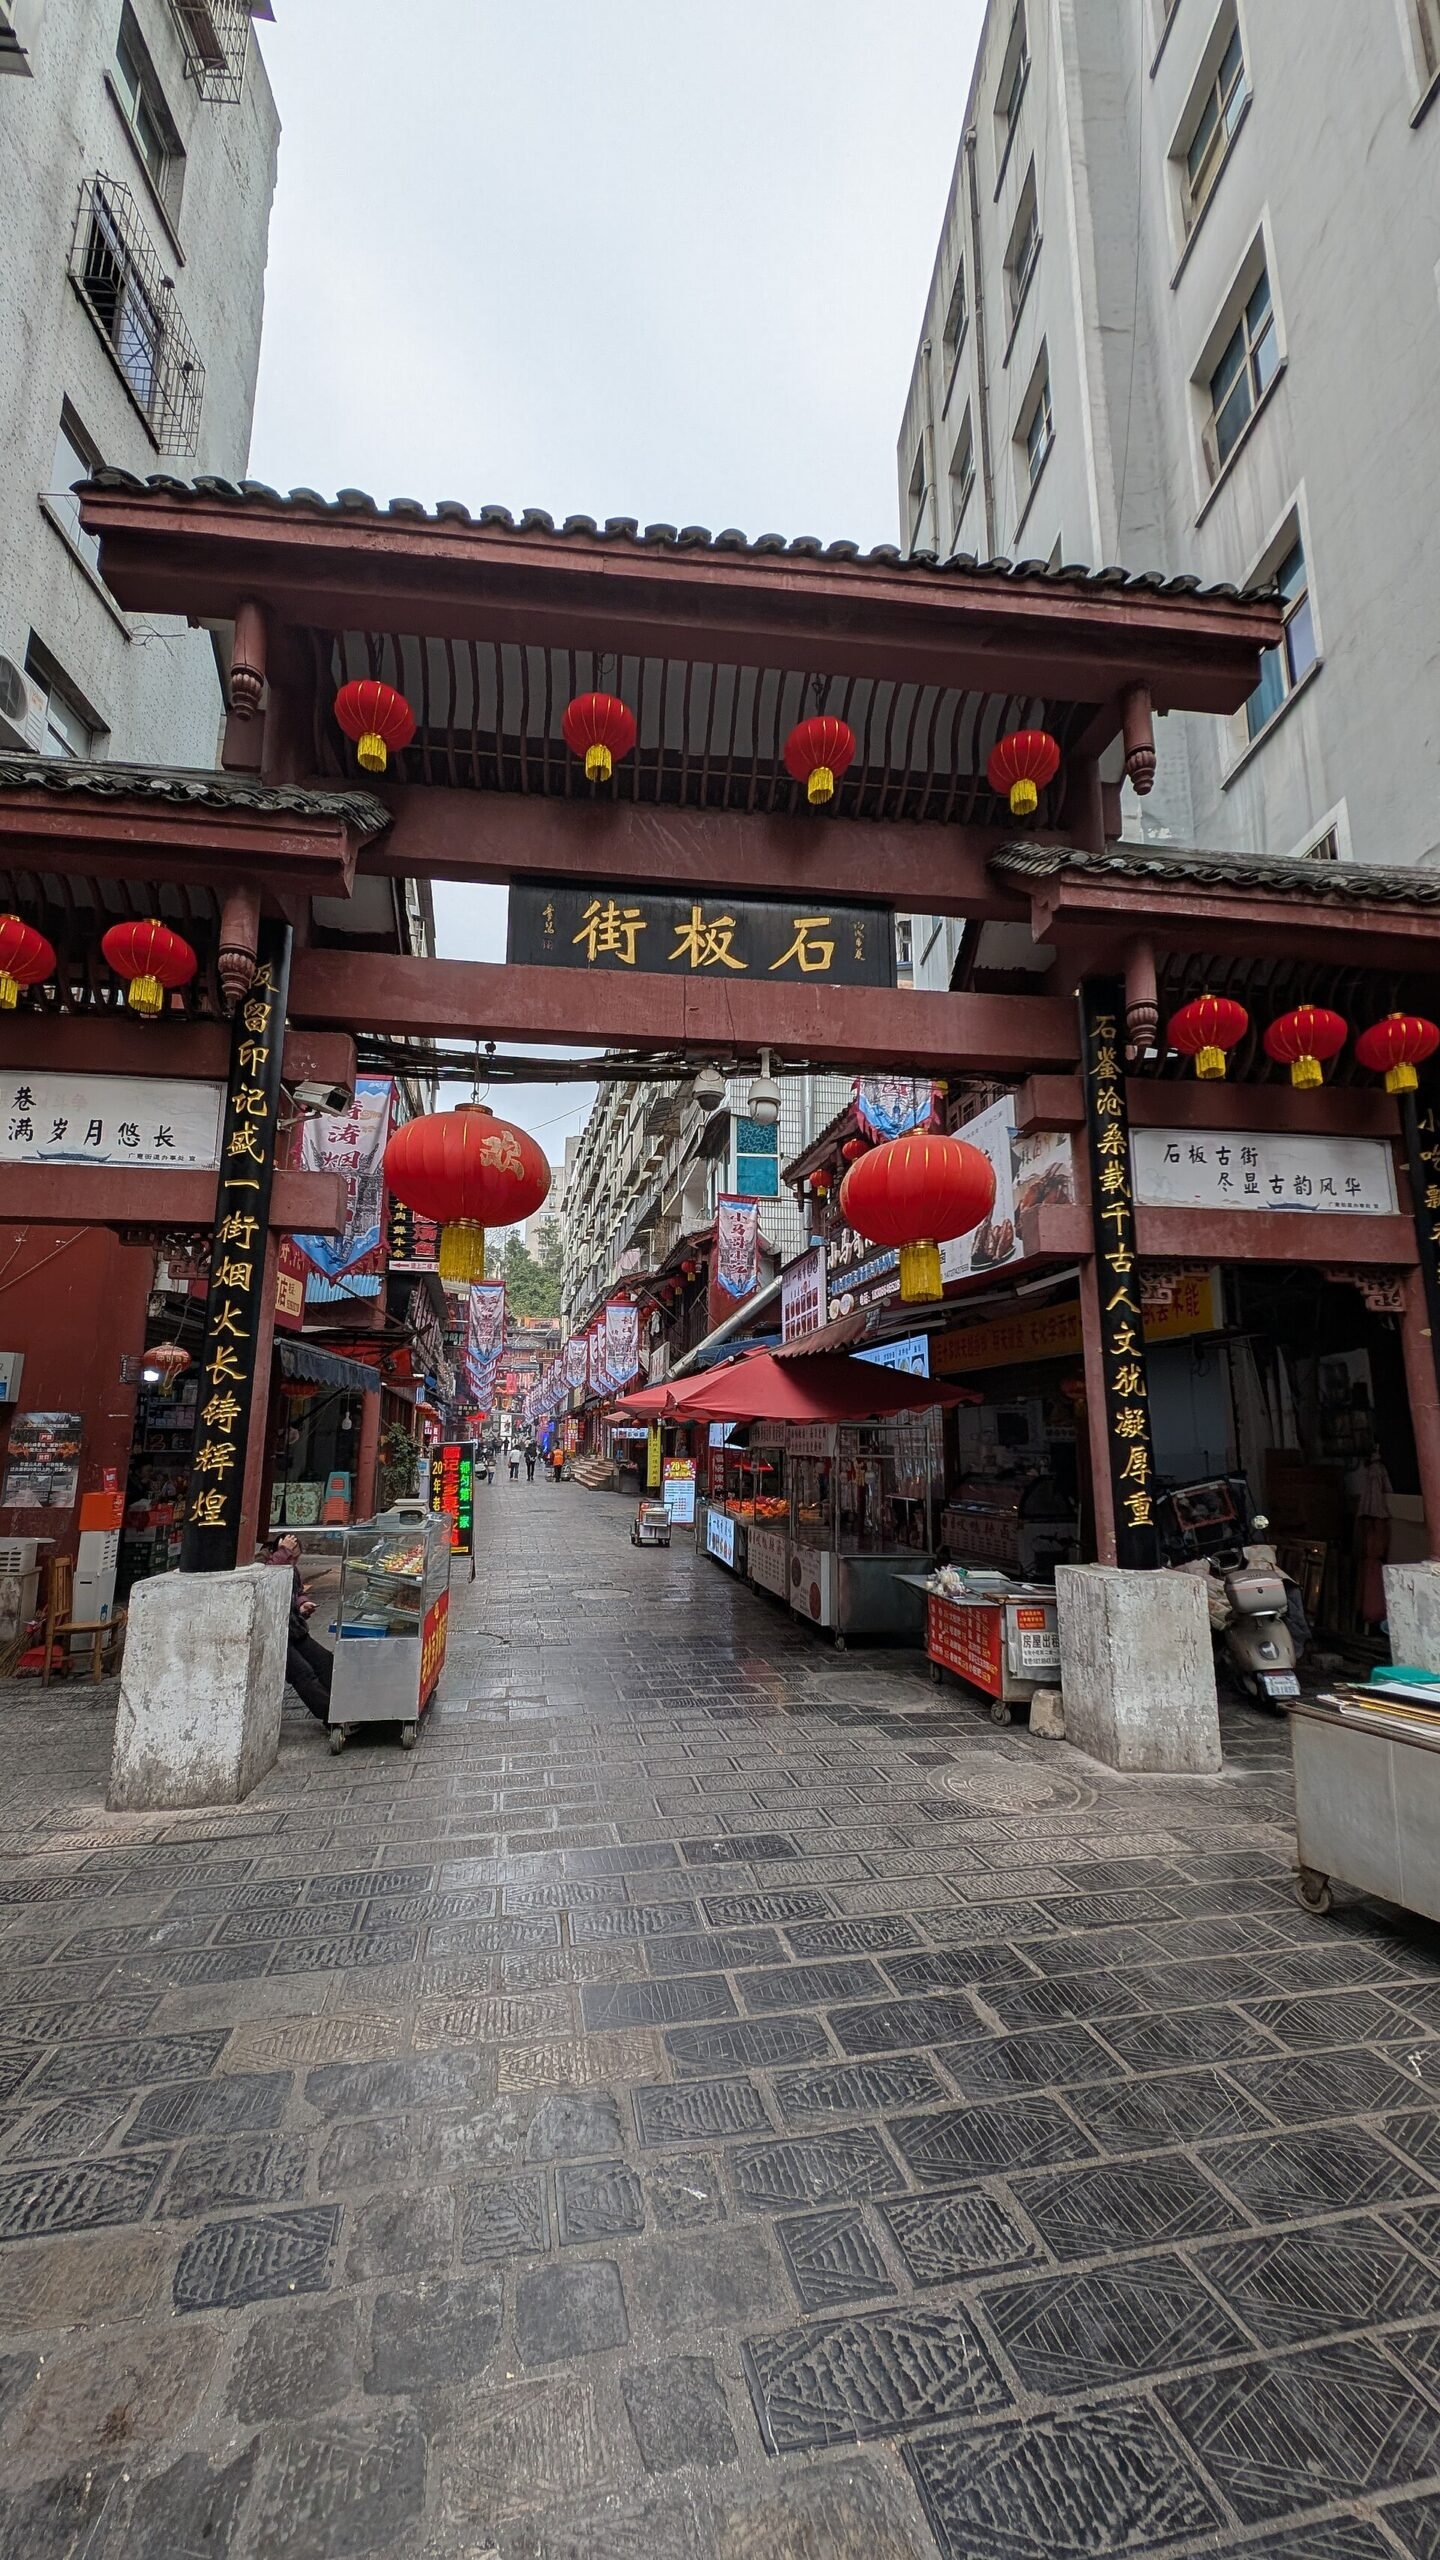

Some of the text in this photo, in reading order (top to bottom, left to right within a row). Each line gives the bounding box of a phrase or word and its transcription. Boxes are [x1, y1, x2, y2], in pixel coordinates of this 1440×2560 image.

[11, 1086, 37, 1112] 巷
[8, 1117, 177, 1149] 满岁月悠长
[1163, 1143, 1260, 1168] 石板古街
[1216, 1171, 1363, 1197] 尽显古韵风华
